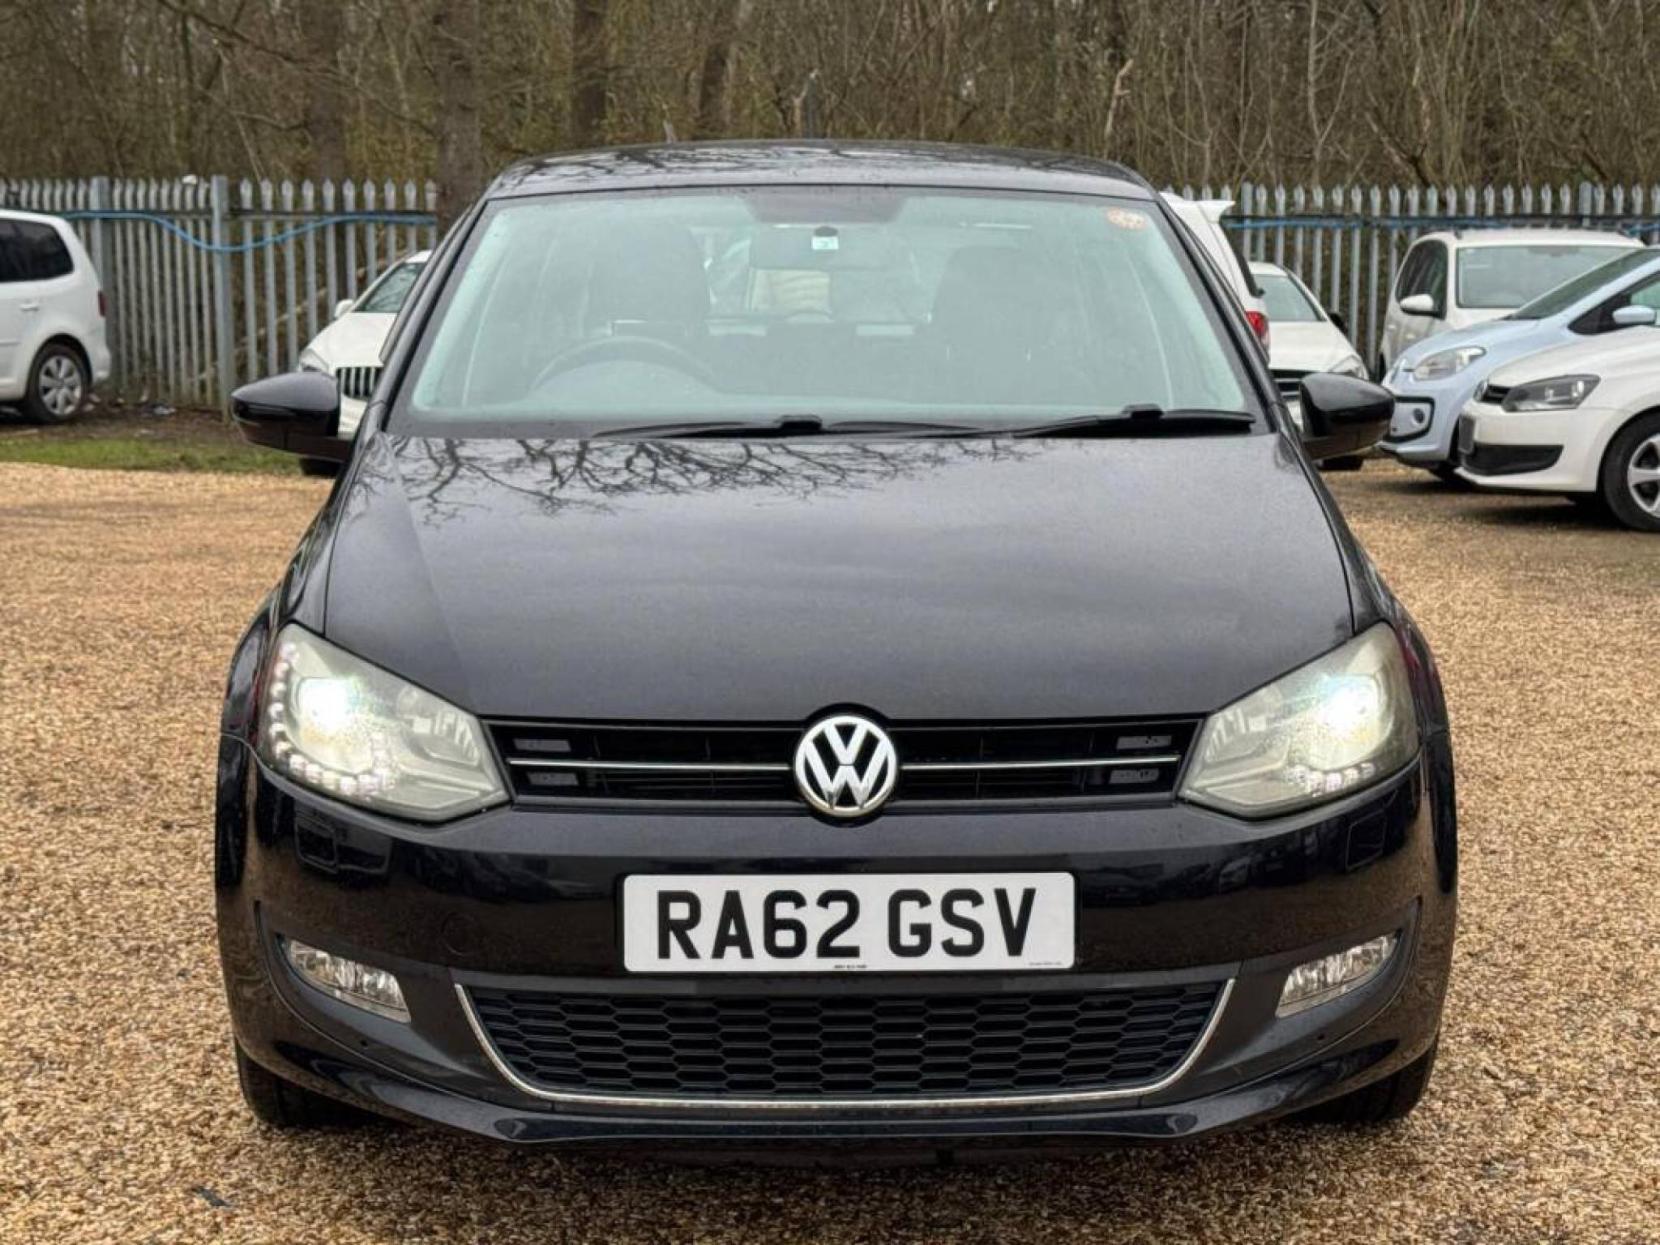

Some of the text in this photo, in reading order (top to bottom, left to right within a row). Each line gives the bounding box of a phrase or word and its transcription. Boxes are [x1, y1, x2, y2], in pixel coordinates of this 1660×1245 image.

[798, 718, 894, 813] VW
[657, 887, 1036, 959] RA62 GSV
